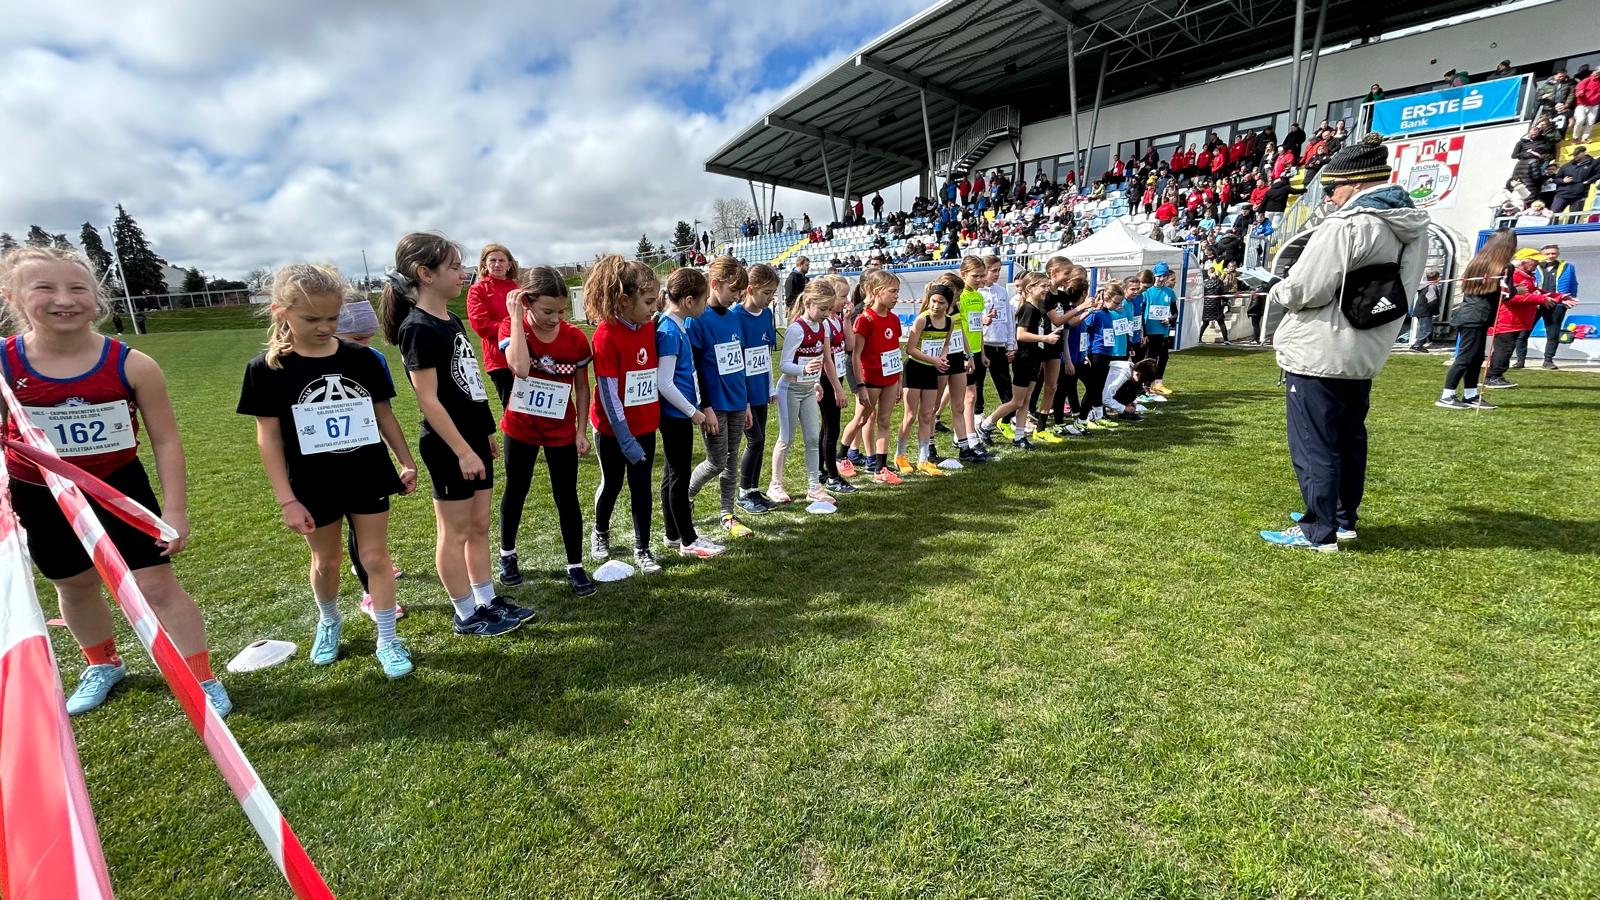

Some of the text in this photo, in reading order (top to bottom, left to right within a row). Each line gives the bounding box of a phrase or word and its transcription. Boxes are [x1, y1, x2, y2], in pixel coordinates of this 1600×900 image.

[1401, 98, 1460, 120] ERSTE
[1400, 117, 1428, 129] Bank
[1413, 194, 1439, 204] VATSKA
[1371, 304, 1396, 314] adidas
[752, 354, 766, 369] 244
[889, 356, 900, 369] 123
[637, 380, 652, 397] 124
[528, 389, 554, 409] 161
[54, 420, 108, 445] 162
[325, 415, 351, 439] 67
